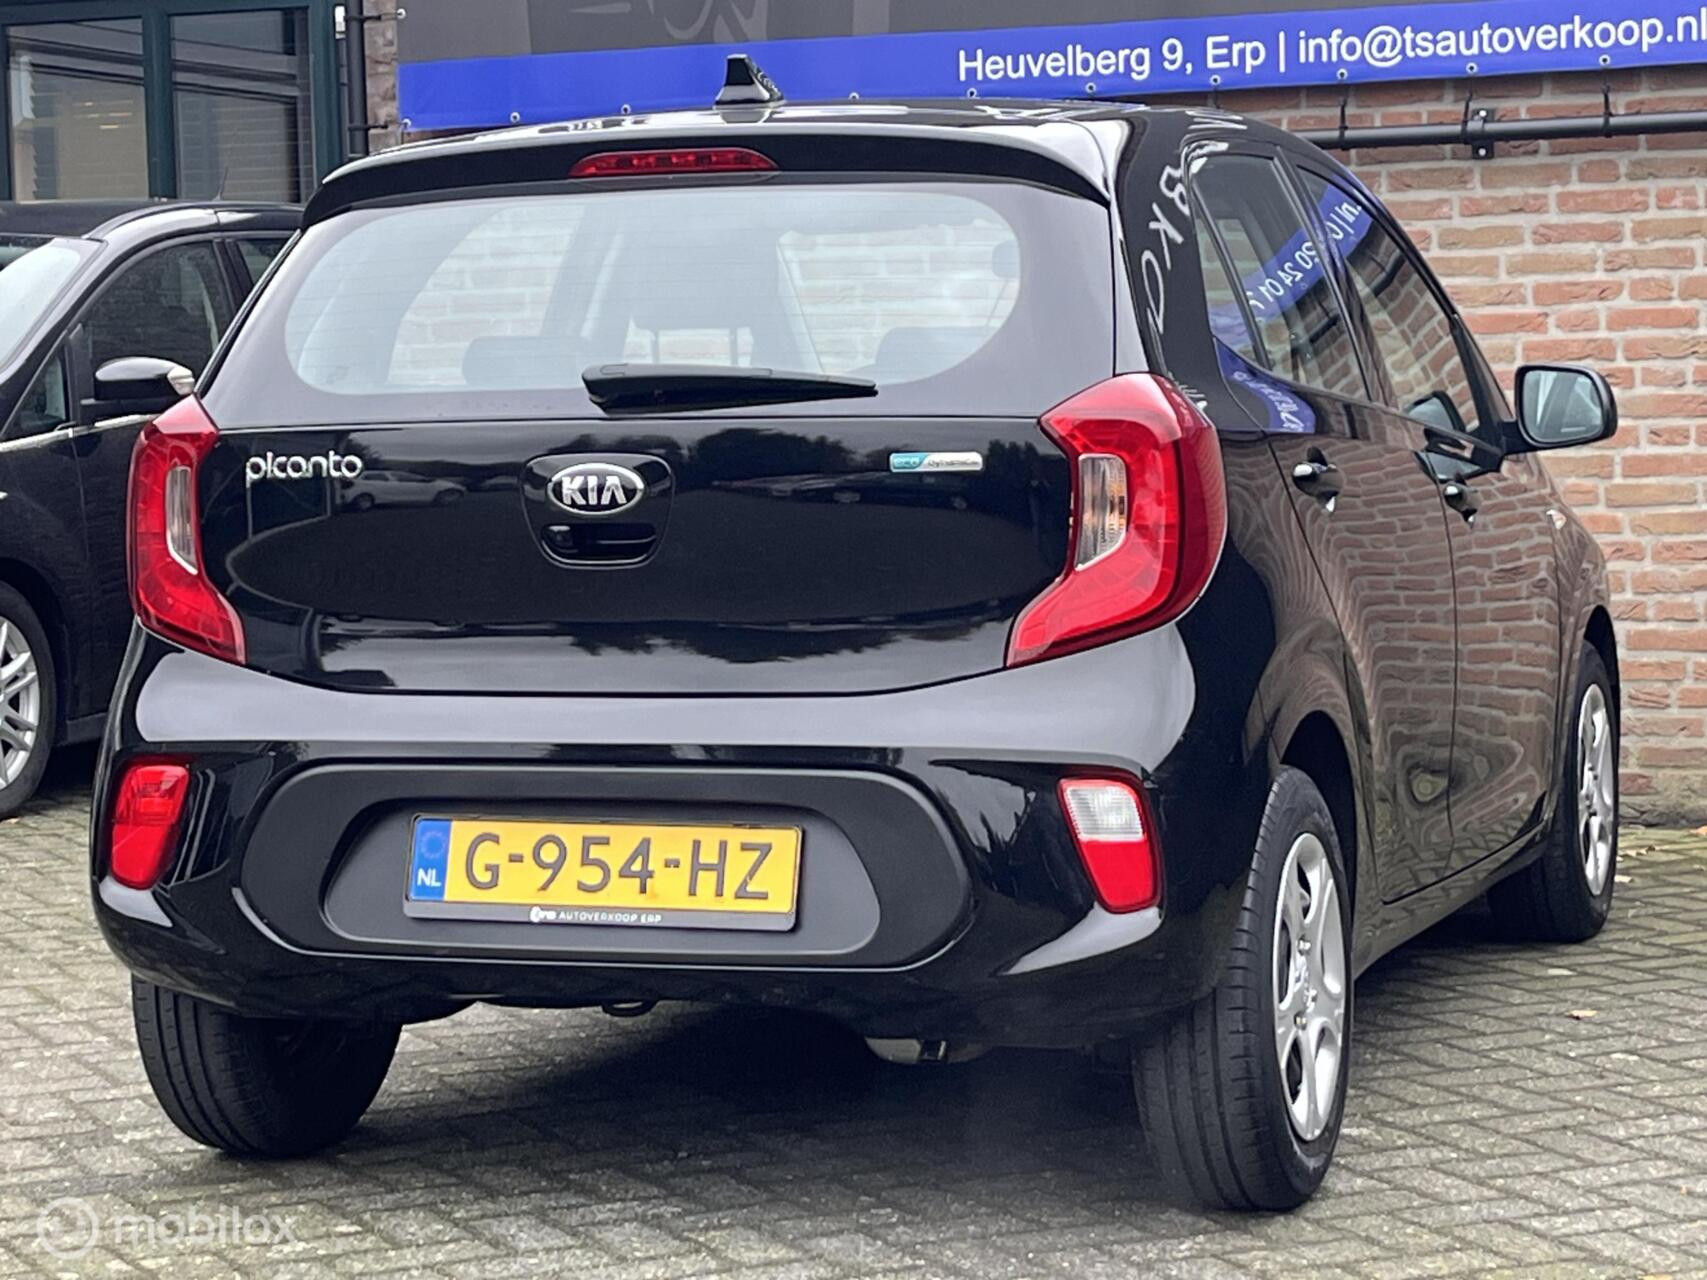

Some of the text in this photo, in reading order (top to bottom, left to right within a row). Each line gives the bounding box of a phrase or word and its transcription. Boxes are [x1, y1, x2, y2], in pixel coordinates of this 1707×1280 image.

[958, 44, 1151, 81] Heuvelberg
[1161, 38, 1193, 75] 9,
[1206, 35, 1266, 75] Erp
[1298, 7, 1707, 68] info@tsautoverkoop.nl
[245, 450, 364, 488] picanto
[560, 475, 627, 506] KIA
[416, 867, 442, 888] NL
[464, 832, 773, 900] G-954-HZ
